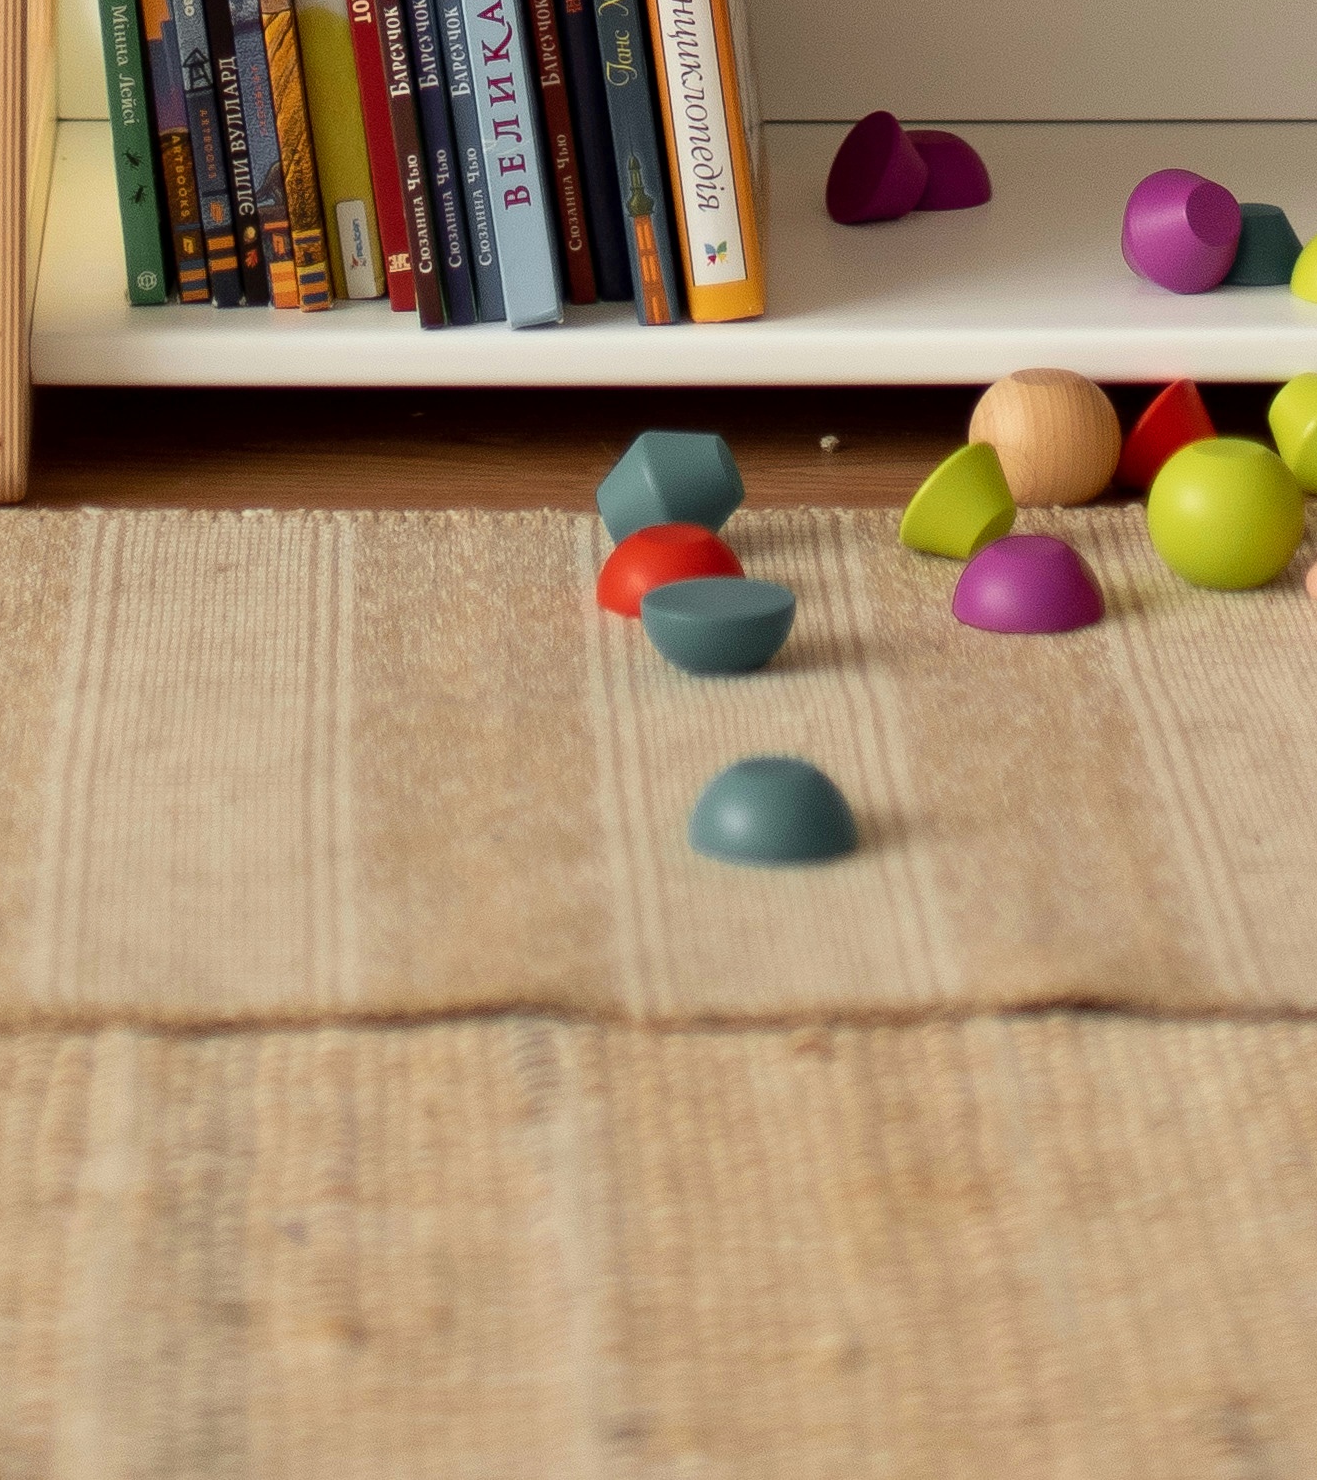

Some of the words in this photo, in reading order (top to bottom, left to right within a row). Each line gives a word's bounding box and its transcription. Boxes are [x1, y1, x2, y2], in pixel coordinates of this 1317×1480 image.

[111, 5, 129, 66] Мінна
[119, 73, 140, 126] Лейсі
[218, 56, 247, 153] ВУЛЛАРД
[171, 135, 191, 218] ARTBOOKS
[234, 156, 255, 216] ЭЛЛИ
